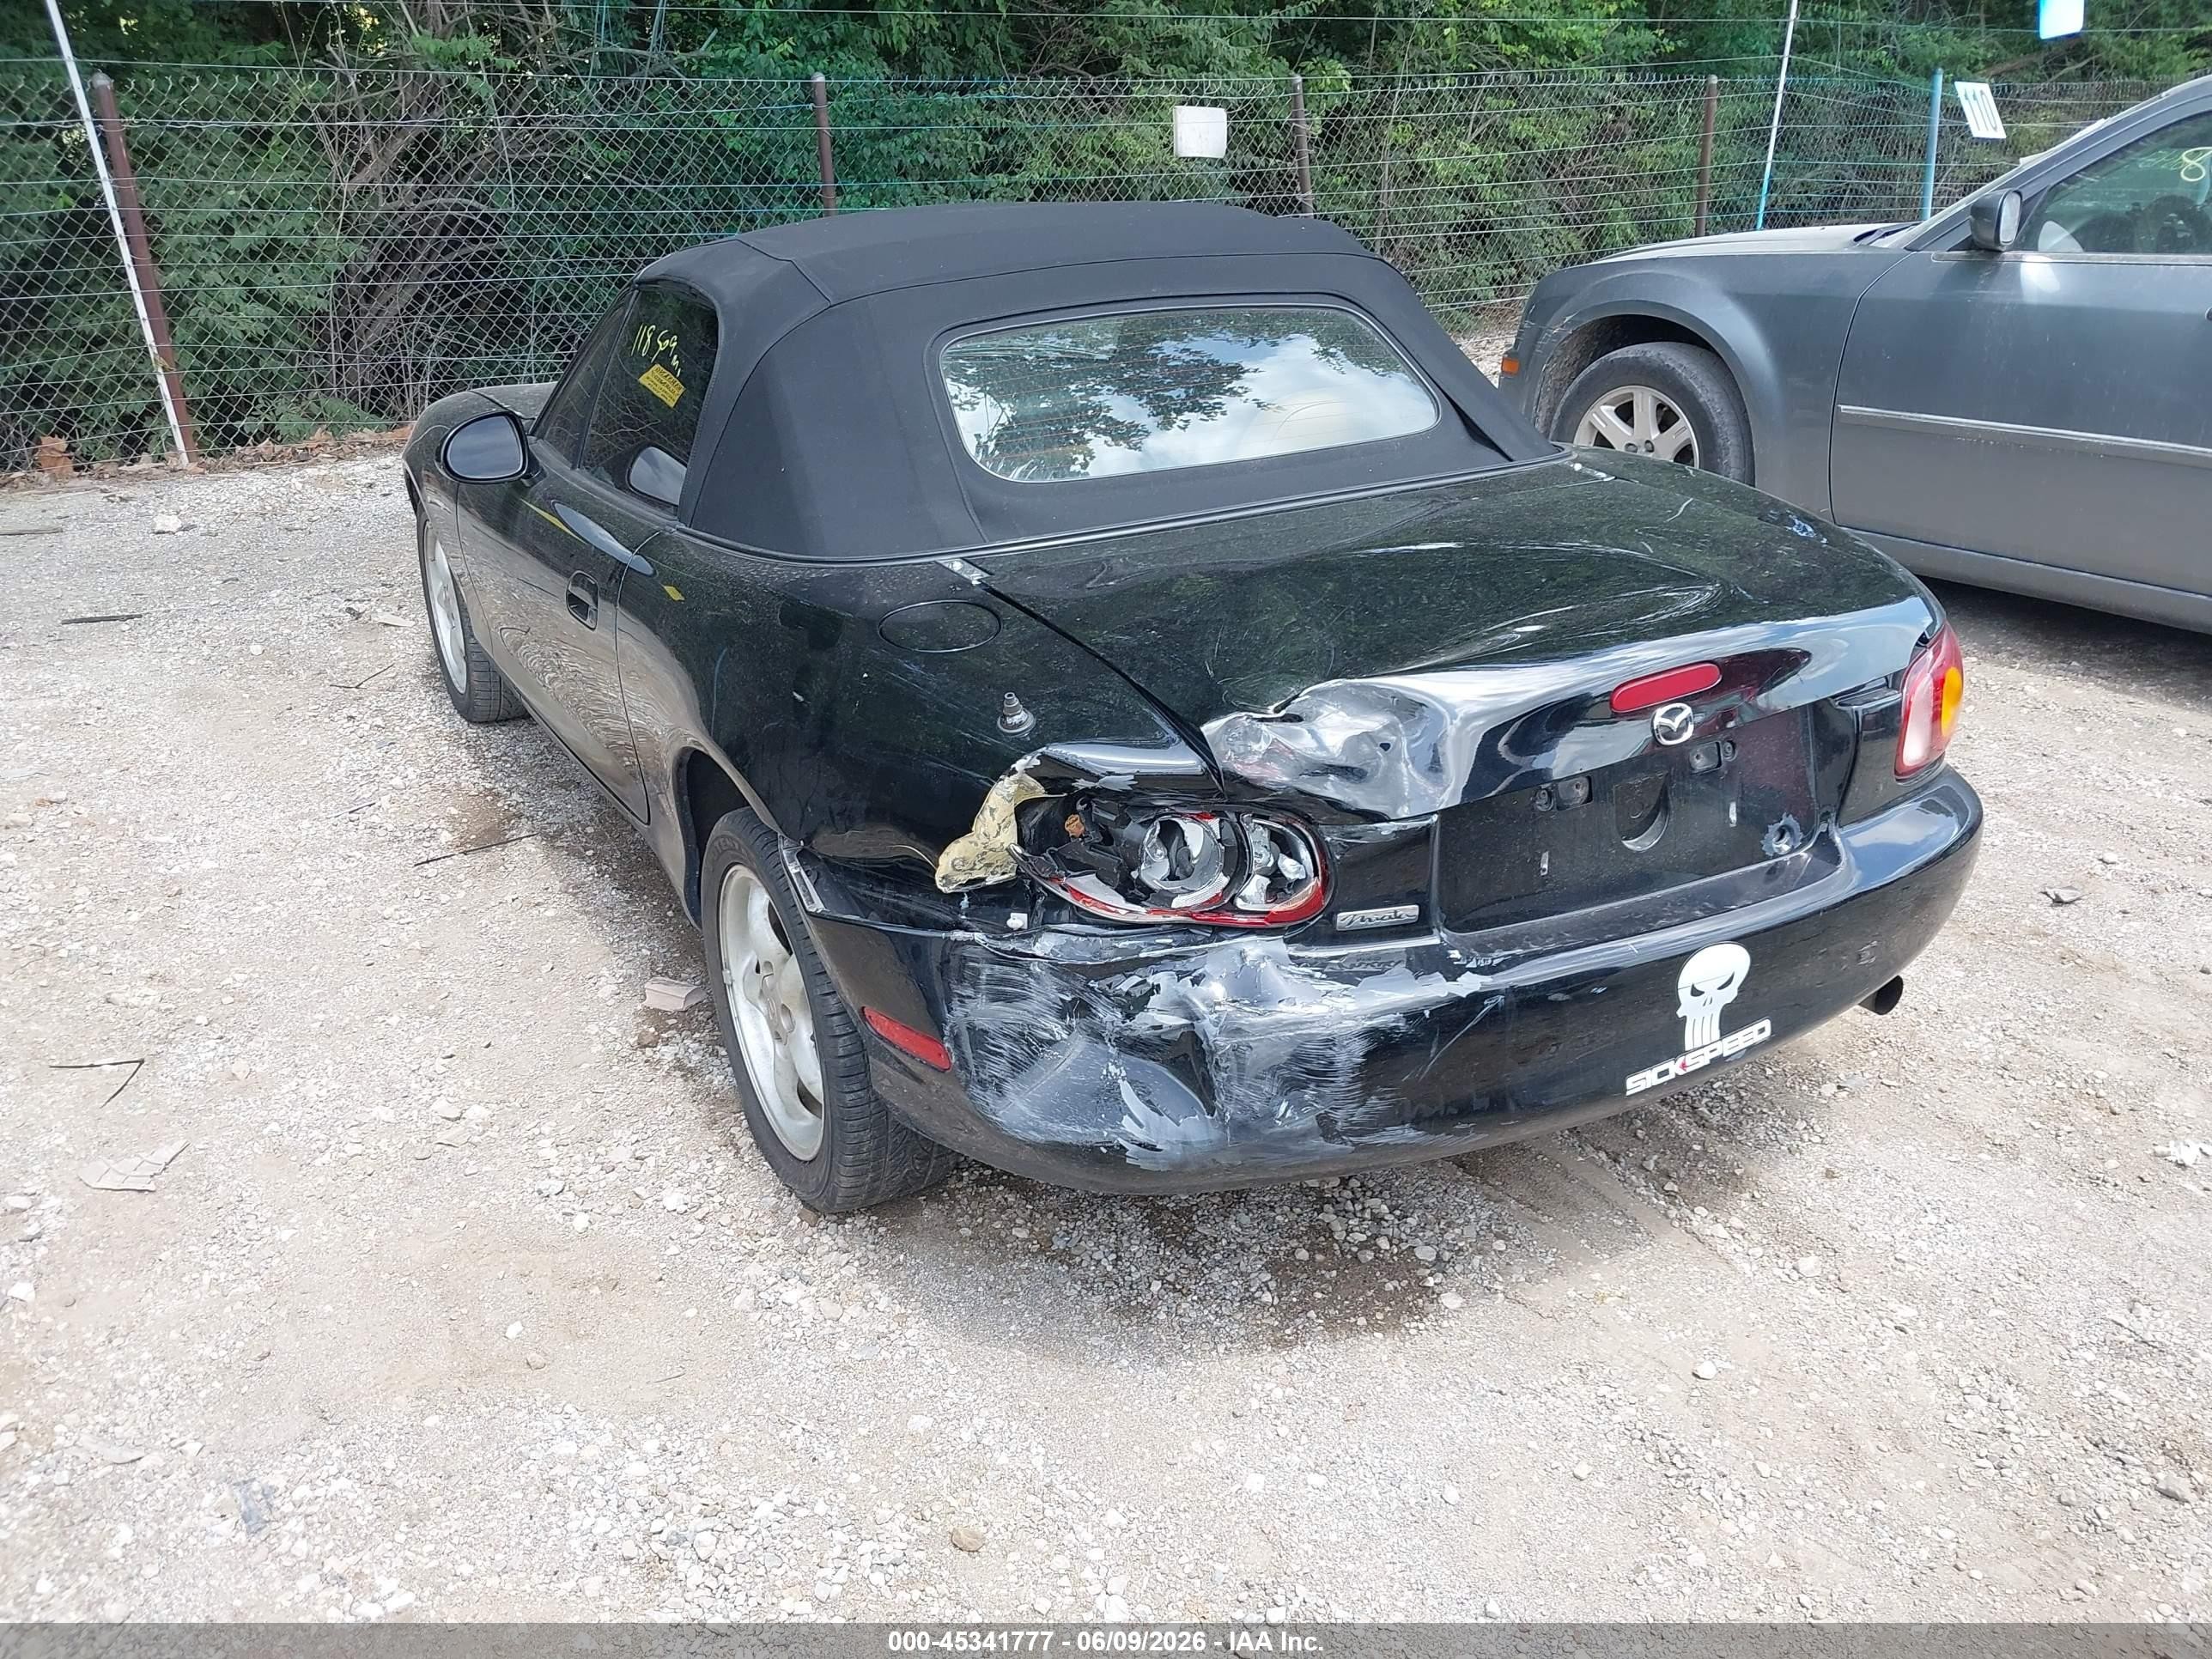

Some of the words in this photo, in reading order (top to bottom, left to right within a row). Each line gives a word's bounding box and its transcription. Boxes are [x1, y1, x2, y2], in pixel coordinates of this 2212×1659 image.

[1963, 88, 1999, 132] 110
[1340, 909, 1417, 928] Miata
[1626, 1018, 1772, 1097] SICKSPEED
